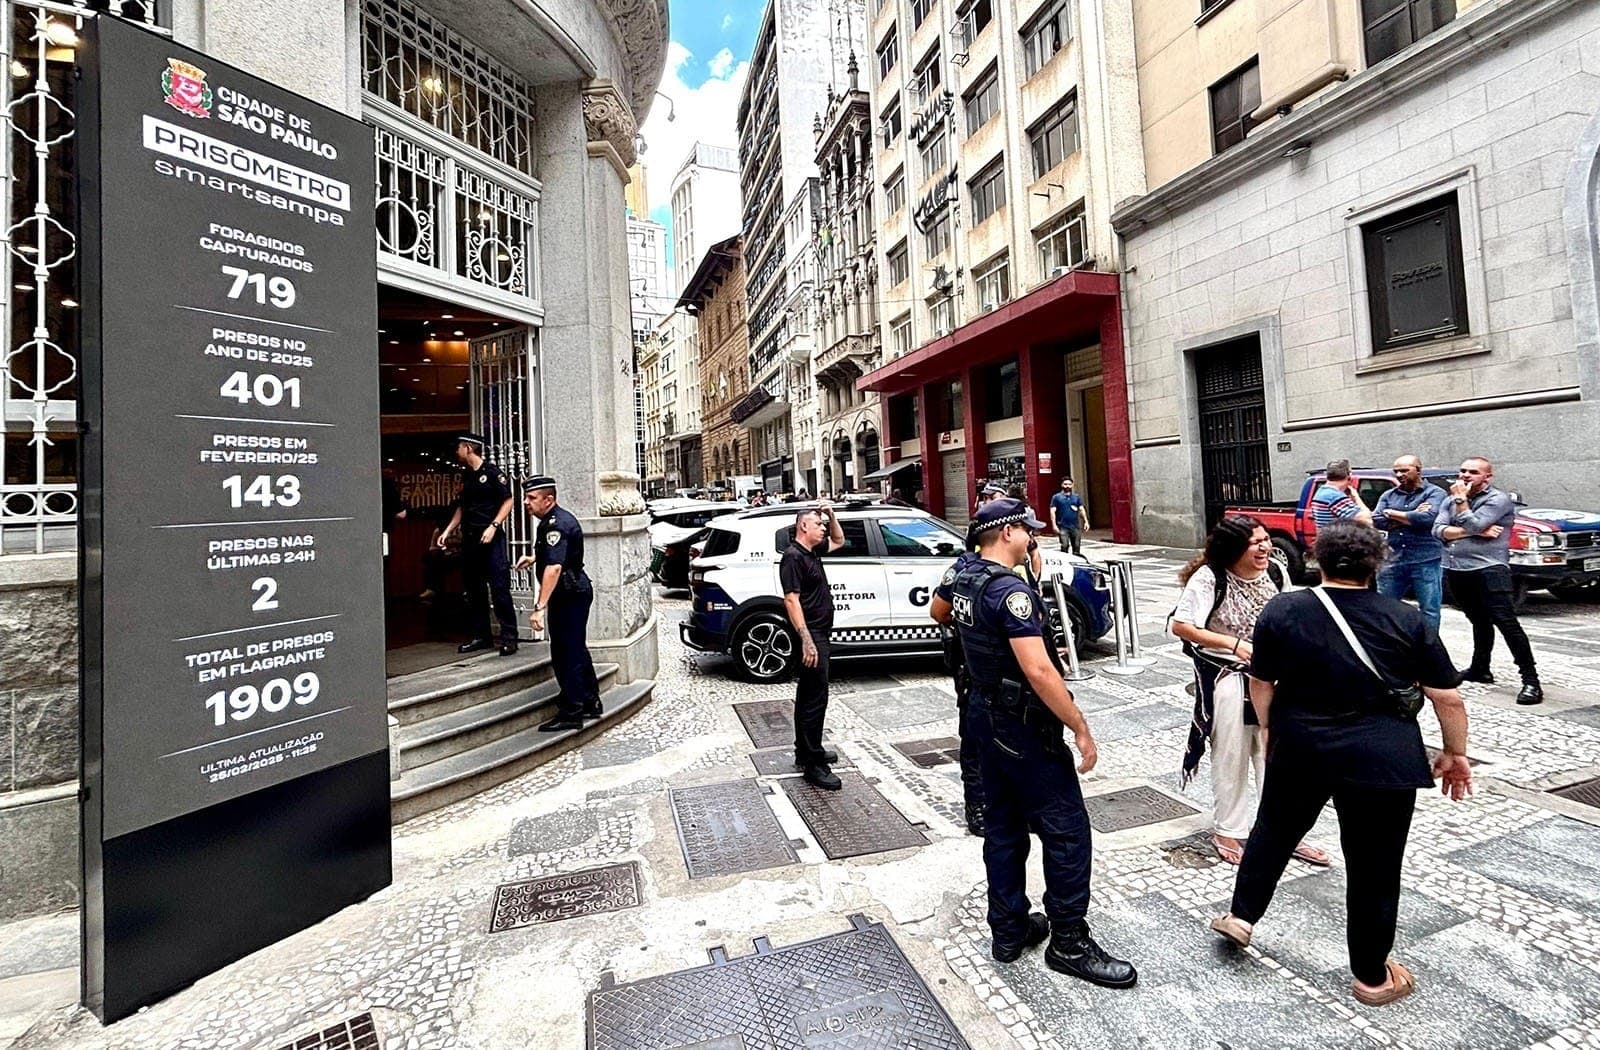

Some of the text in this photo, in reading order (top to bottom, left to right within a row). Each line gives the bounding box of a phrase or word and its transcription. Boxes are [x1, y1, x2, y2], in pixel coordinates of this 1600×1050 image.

[217, 86, 312, 134] CIDADE DE
[217, 103, 338, 161] SÃO PAULO
[155, 126, 342, 202] PRISÔMETRO
[154, 158, 345, 227] smartsampa
[199, 237, 314, 273] CAPTURADOS
[209, 222, 305, 256] FORAGIDOS
[221, 264, 296, 309] 719
[204, 343, 314, 368] ANO DE 2025
[212, 328, 306, 352] PRESOS NO
[219, 371, 301, 408] 401
[199, 450, 318, 465] FEVEREIRO/25
[213, 434, 307, 450] PRESOS EM
[222, 474, 302, 508] 143
[207, 550, 316, 570] ÚLTIMAS 24H
[208, 534, 314, 553] PRESOS NAS
[251, 576, 279, 612] 2
[832, 592, 876, 600] TETORA
[952, 595, 971, 617] GCM
[185, 631, 334, 668] TOTAL DE PRESOS
[199, 648, 326, 683] EM FLAGRANTE
[205, 671, 320, 727] 1909
[248, 732, 324, 761] ATUALIZAÇÃO
